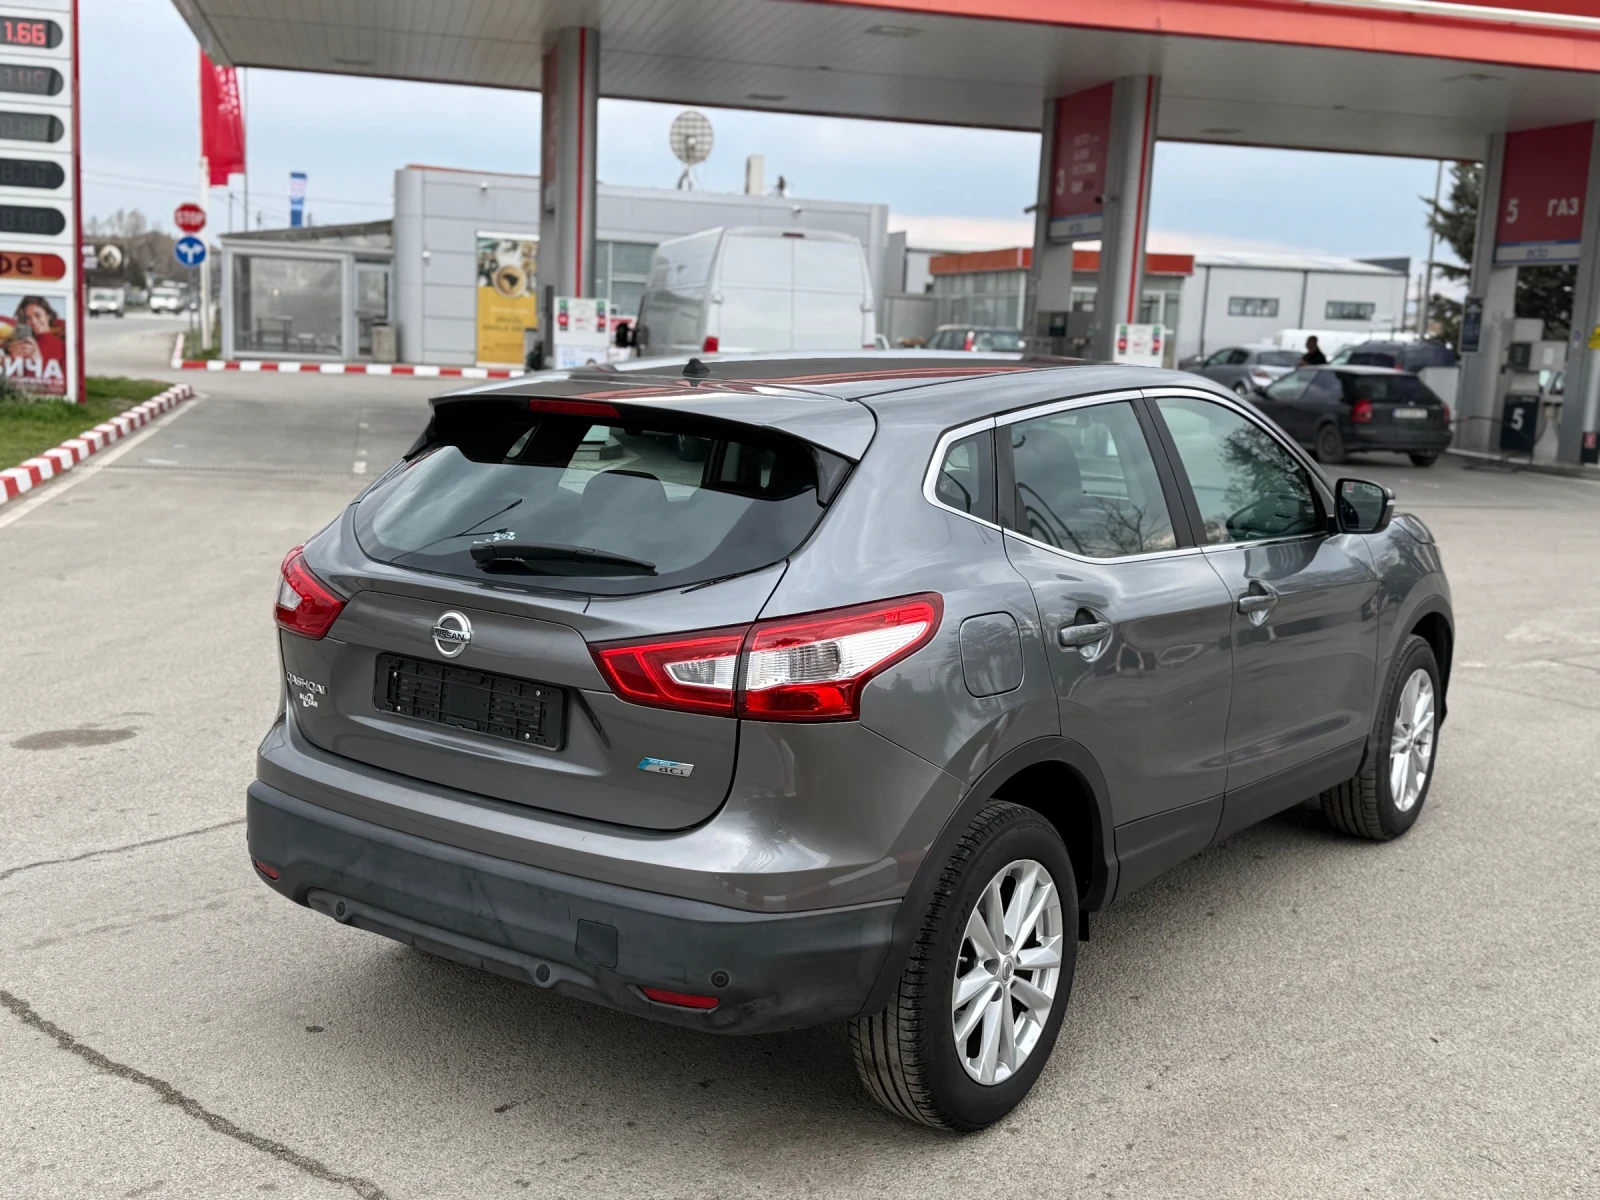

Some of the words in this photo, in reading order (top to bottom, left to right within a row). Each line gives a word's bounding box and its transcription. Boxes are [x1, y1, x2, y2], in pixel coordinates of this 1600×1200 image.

[4, 21, 47, 46] 1.66
[1055, 168, 1065, 196] 3
[175, 210, 205, 225] STOP
[1506, 198, 1519, 224] 5
[1547, 196, 1579, 217] ГАЗ
[0, 356, 65, 379] ИЧА
[1510, 407, 1525, 430] 5
[434, 628, 466, 642] NISSAN
[286, 671, 326, 695] QASHQAI
[659, 766, 684, 775] dCi
